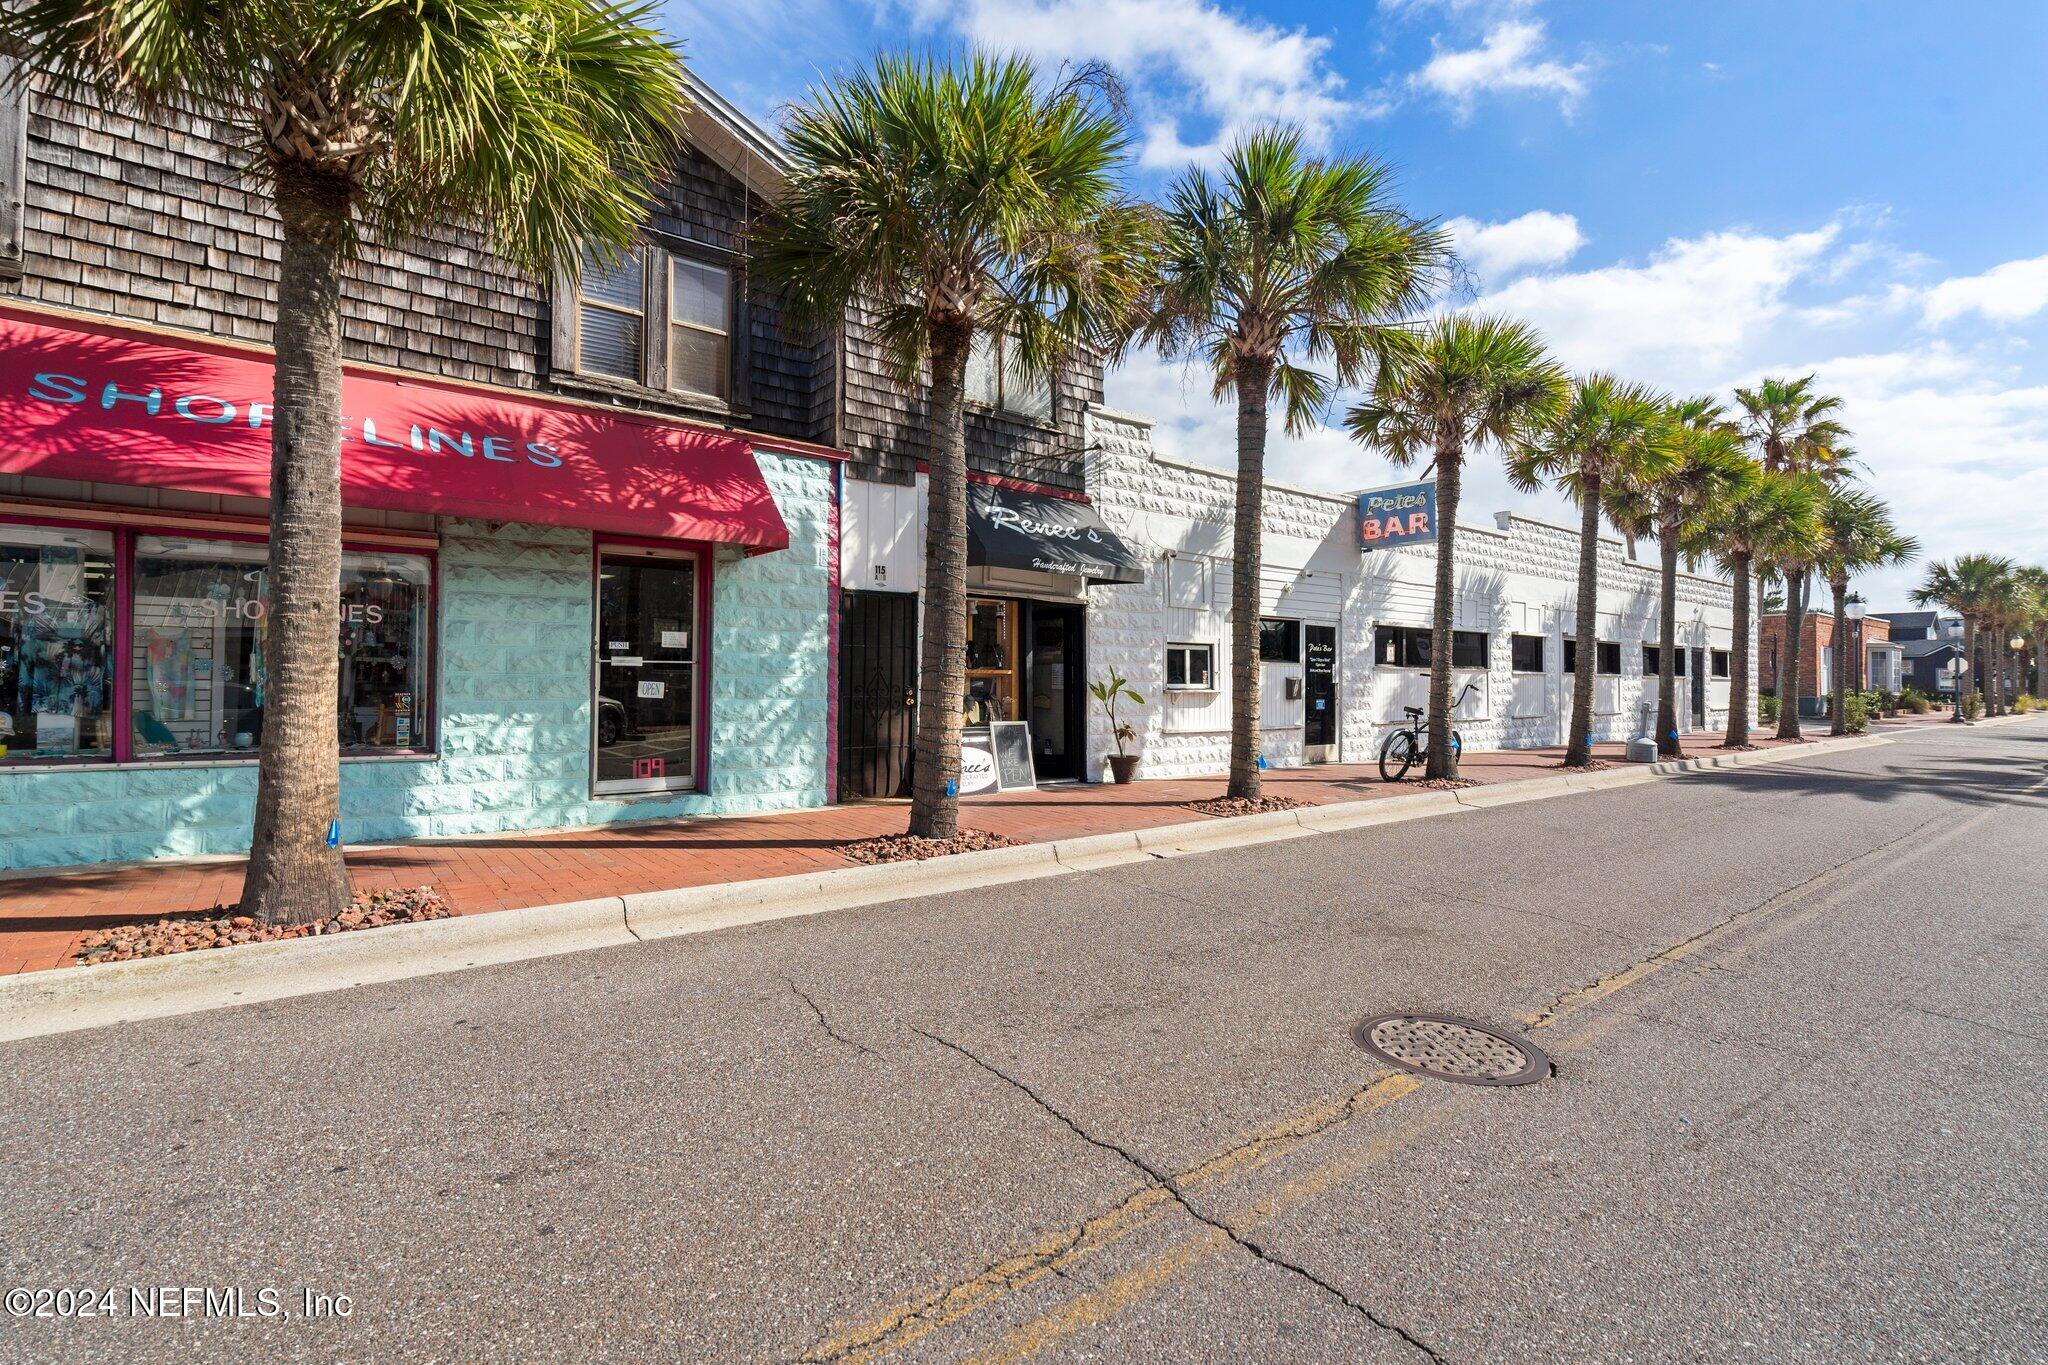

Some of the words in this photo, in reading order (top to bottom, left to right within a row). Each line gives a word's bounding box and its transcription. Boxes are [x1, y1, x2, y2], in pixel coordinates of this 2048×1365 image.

[1362, 512, 1431, 541] BAR
[874, 564, 886, 575] 115
[1032, 557, 1076, 572] Handcrafted
[1079, 563, 1104, 577] Jewelry
[642, 682, 661, 696] OPEN
[633, 758, 665, 779] 109
